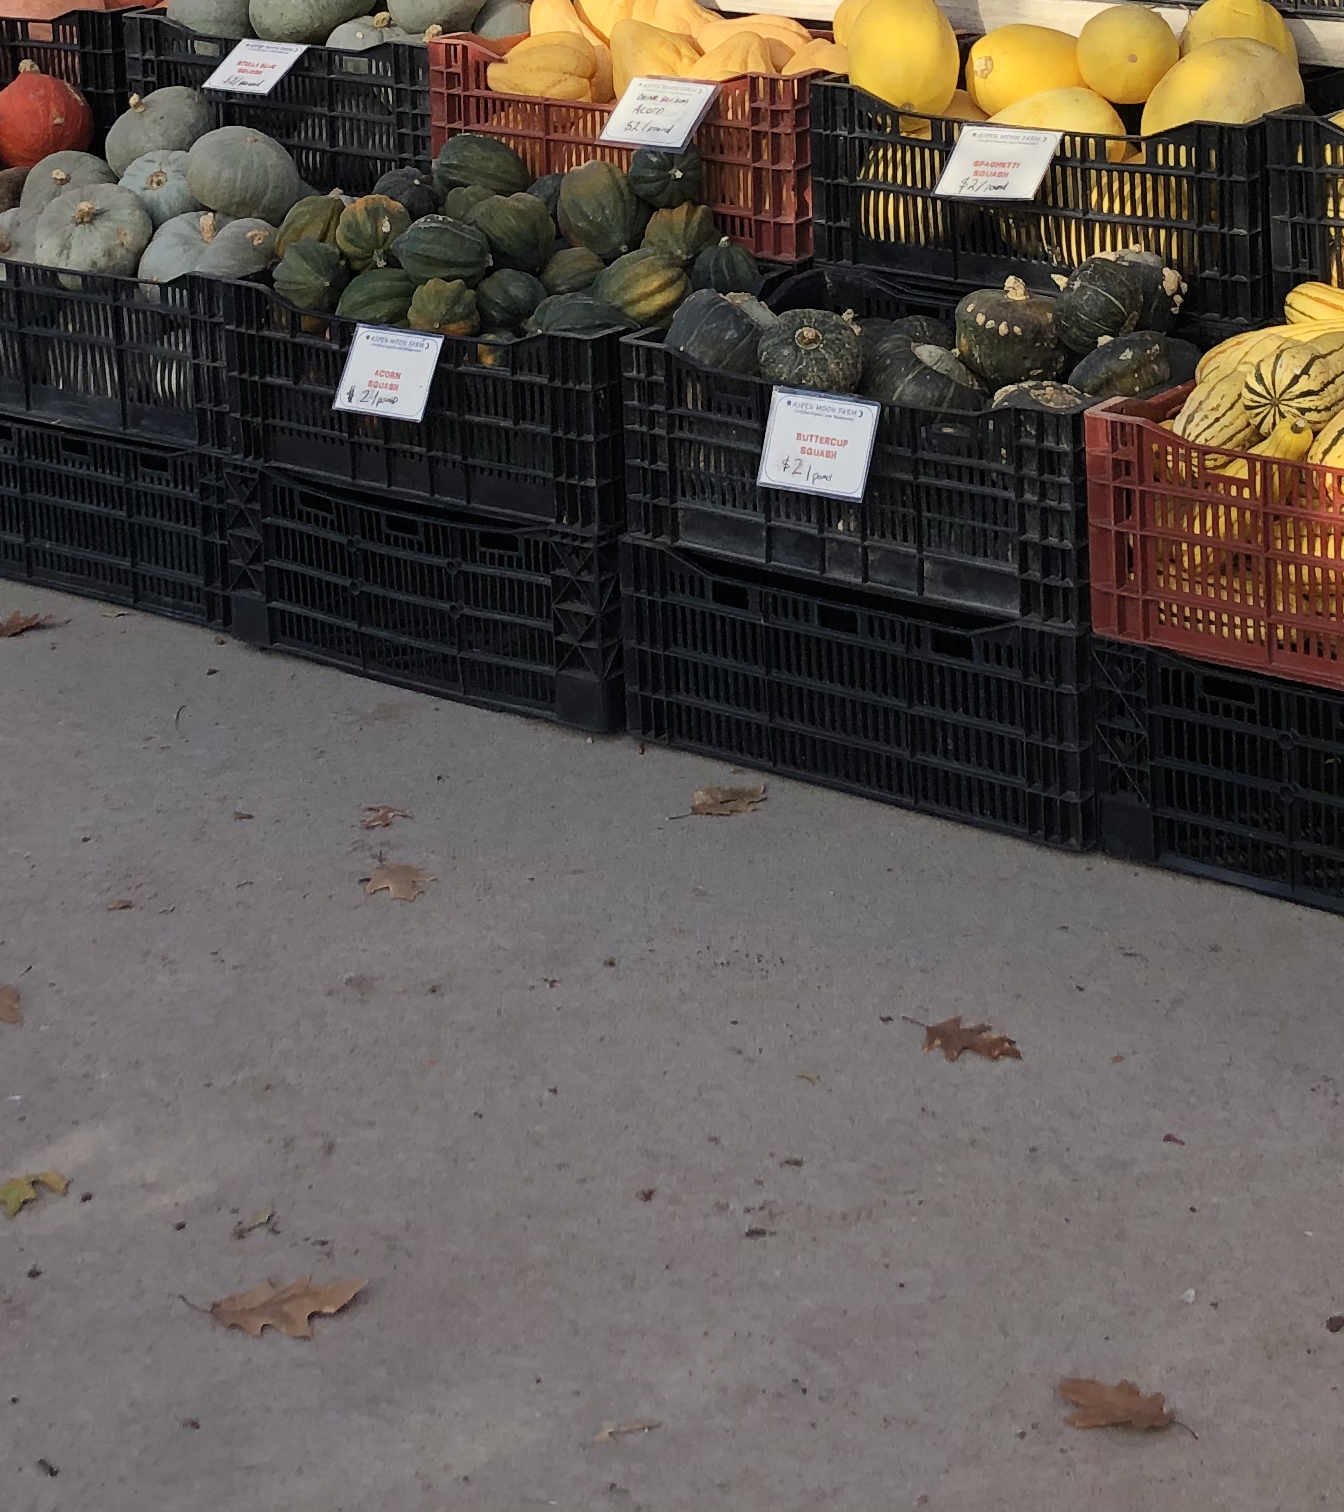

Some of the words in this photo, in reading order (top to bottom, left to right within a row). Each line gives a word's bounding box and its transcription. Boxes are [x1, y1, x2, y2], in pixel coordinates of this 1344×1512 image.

[632, 104, 665, 116] Acorn
[973, 160, 1021, 169] SPAGHETTI
[972, 170, 1010, 178] SQUASH
[374, 369, 402, 380] ACORN
[367, 379, 399, 392] SQUASH
[792, 401, 814, 411] ASPEN
[815, 403, 837, 414] MOON
[838, 406, 858, 416] FARM
[795, 432, 849, 448] BUTTERCUP
[799, 446, 838, 460] SQUASH
